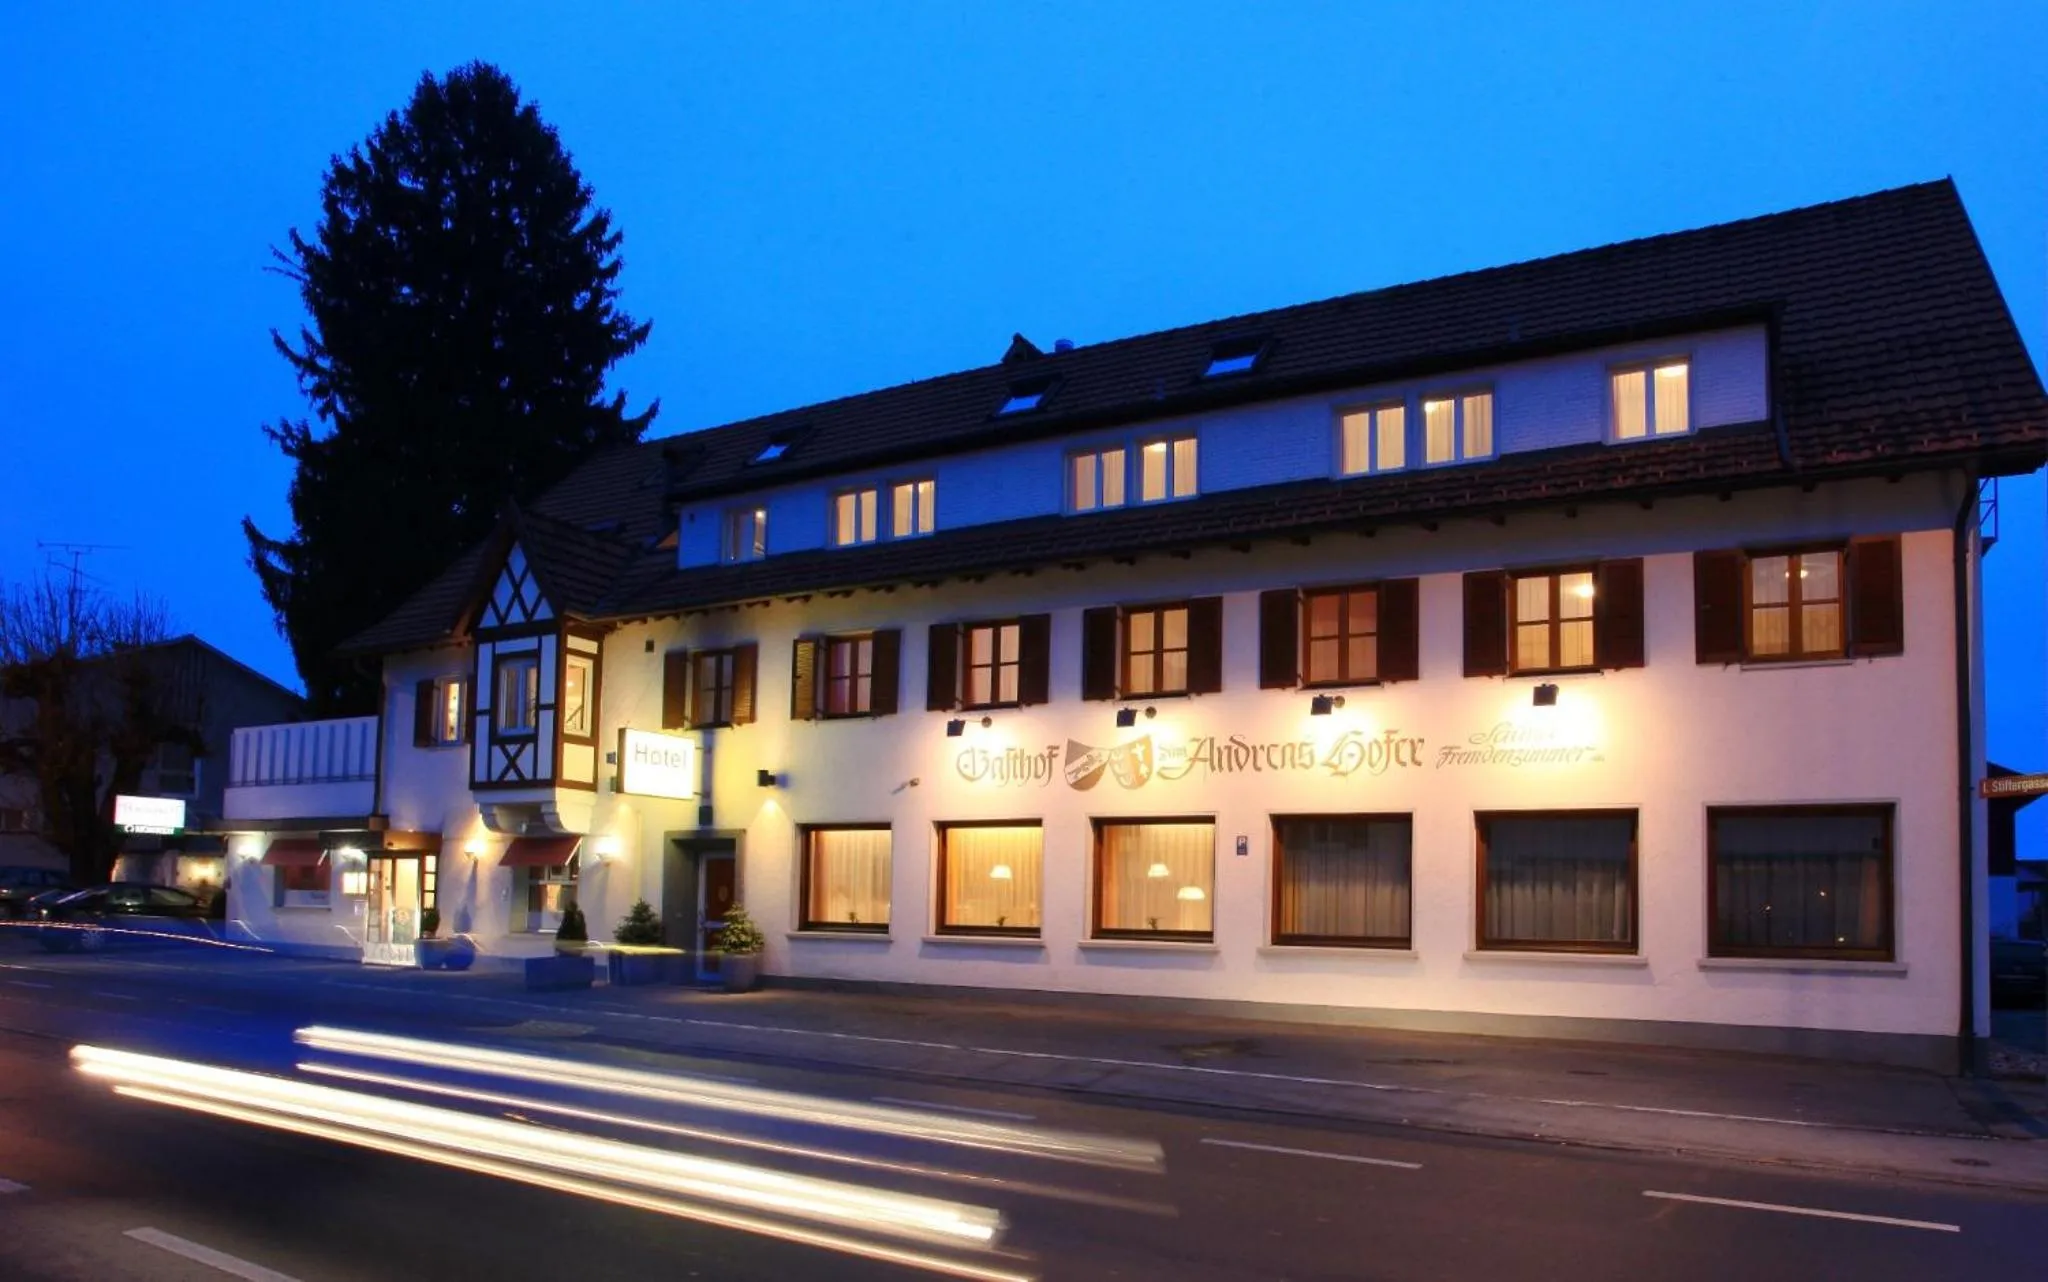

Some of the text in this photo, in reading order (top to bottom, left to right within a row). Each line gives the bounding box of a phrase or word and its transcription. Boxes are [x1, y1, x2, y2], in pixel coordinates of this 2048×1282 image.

[634, 741, 687, 769] Hotel
[956, 745, 1060, 787] Gasthof
[1157, 734, 1315, 781] Andreas
[1321, 729, 1425, 776] Hofer
